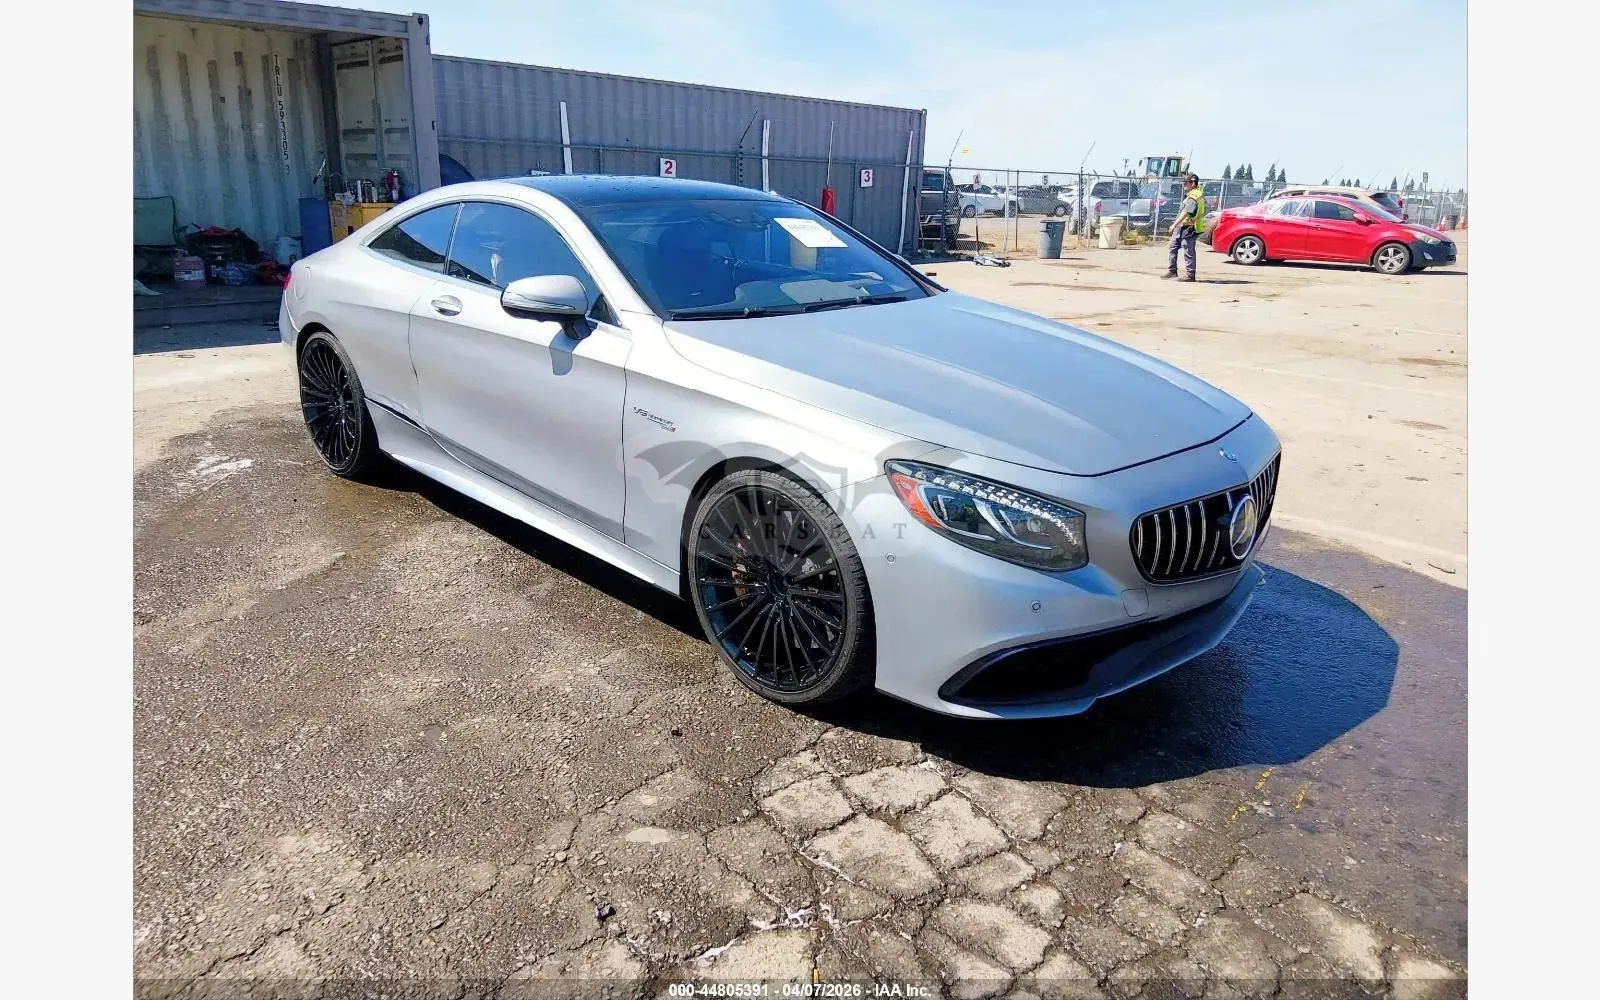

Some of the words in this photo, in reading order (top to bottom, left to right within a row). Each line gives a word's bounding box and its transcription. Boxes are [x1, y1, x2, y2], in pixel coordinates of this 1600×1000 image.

[274, 54, 282, 96] TRLU
[664, 160, 673, 175] 2
[864, 170, 871, 183] 3
[974, 175, 980, 186] 4
[1043, 175, 1048, 185] 5
